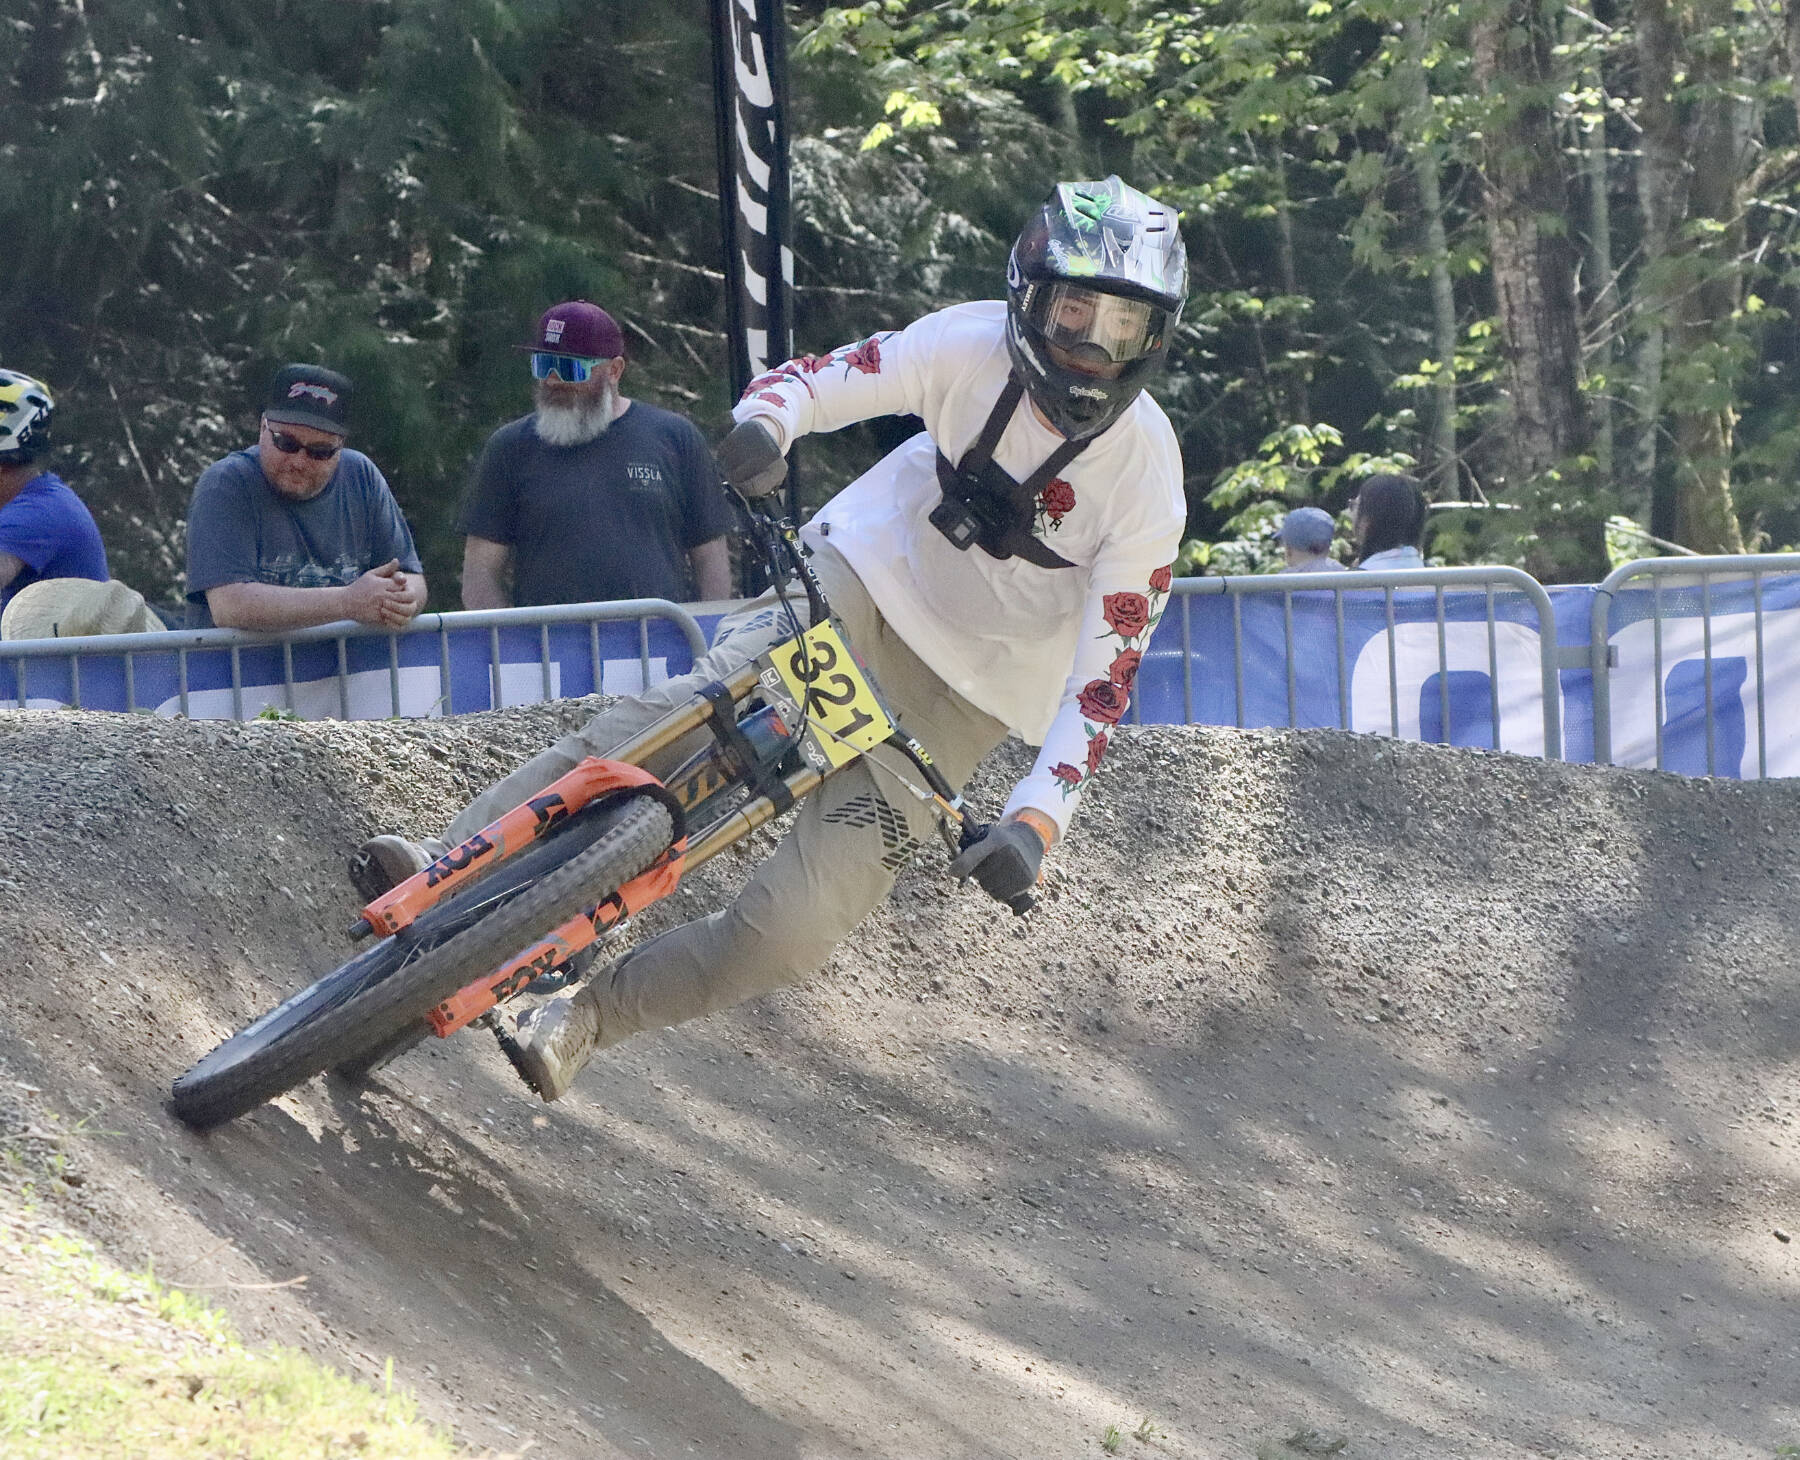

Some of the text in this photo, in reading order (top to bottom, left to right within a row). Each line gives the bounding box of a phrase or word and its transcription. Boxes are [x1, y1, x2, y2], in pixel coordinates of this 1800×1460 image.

[627, 467, 662, 481] VISSLA
[793, 539, 829, 604] BURGTEC
[790, 641, 874, 743] 321
[425, 829, 495, 889] FOX
[491, 948, 557, 1001] FOX
